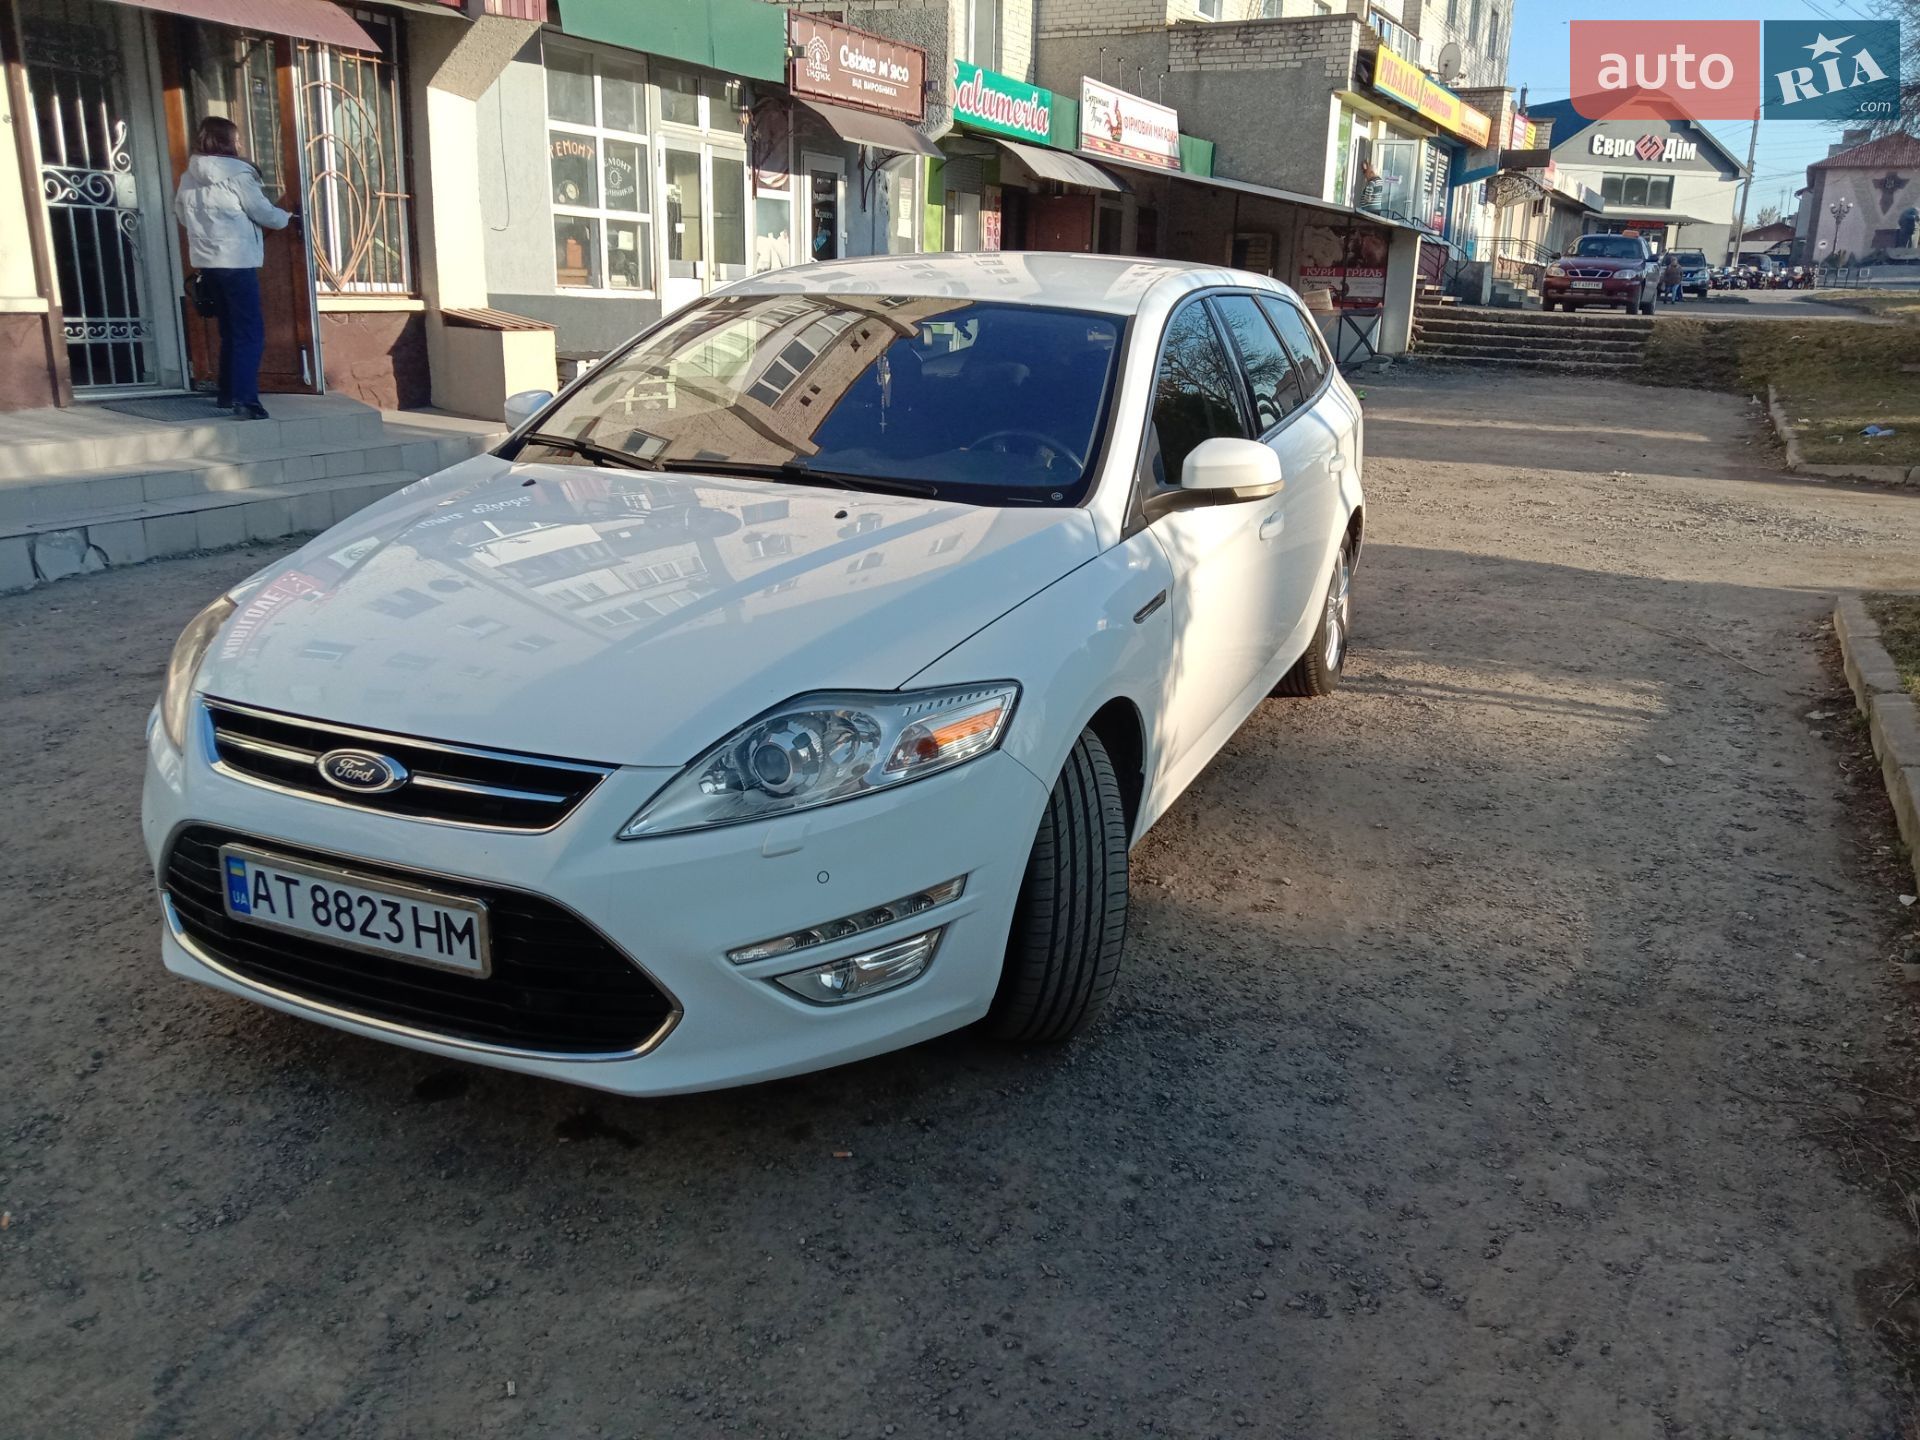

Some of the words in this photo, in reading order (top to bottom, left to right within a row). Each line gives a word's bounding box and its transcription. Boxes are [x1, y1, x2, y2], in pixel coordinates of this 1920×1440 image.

[839, 44, 876, 74] Свіже
[863, 81, 897, 97] ВИРОБНИКА
[1592, 133, 1636, 158] Євро
[1662, 138, 1697, 162] Дім
[1306, 268, 1336, 276] КУРИ
[1346, 268, 1383, 277] ГРИЛЬ
[335, 758, 375, 783] Ford
[233, 890, 248, 906] UA
[253, 870, 300, 919] AT
[310, 884, 404, 943] 8823
[411, 906, 477, 960] HM
